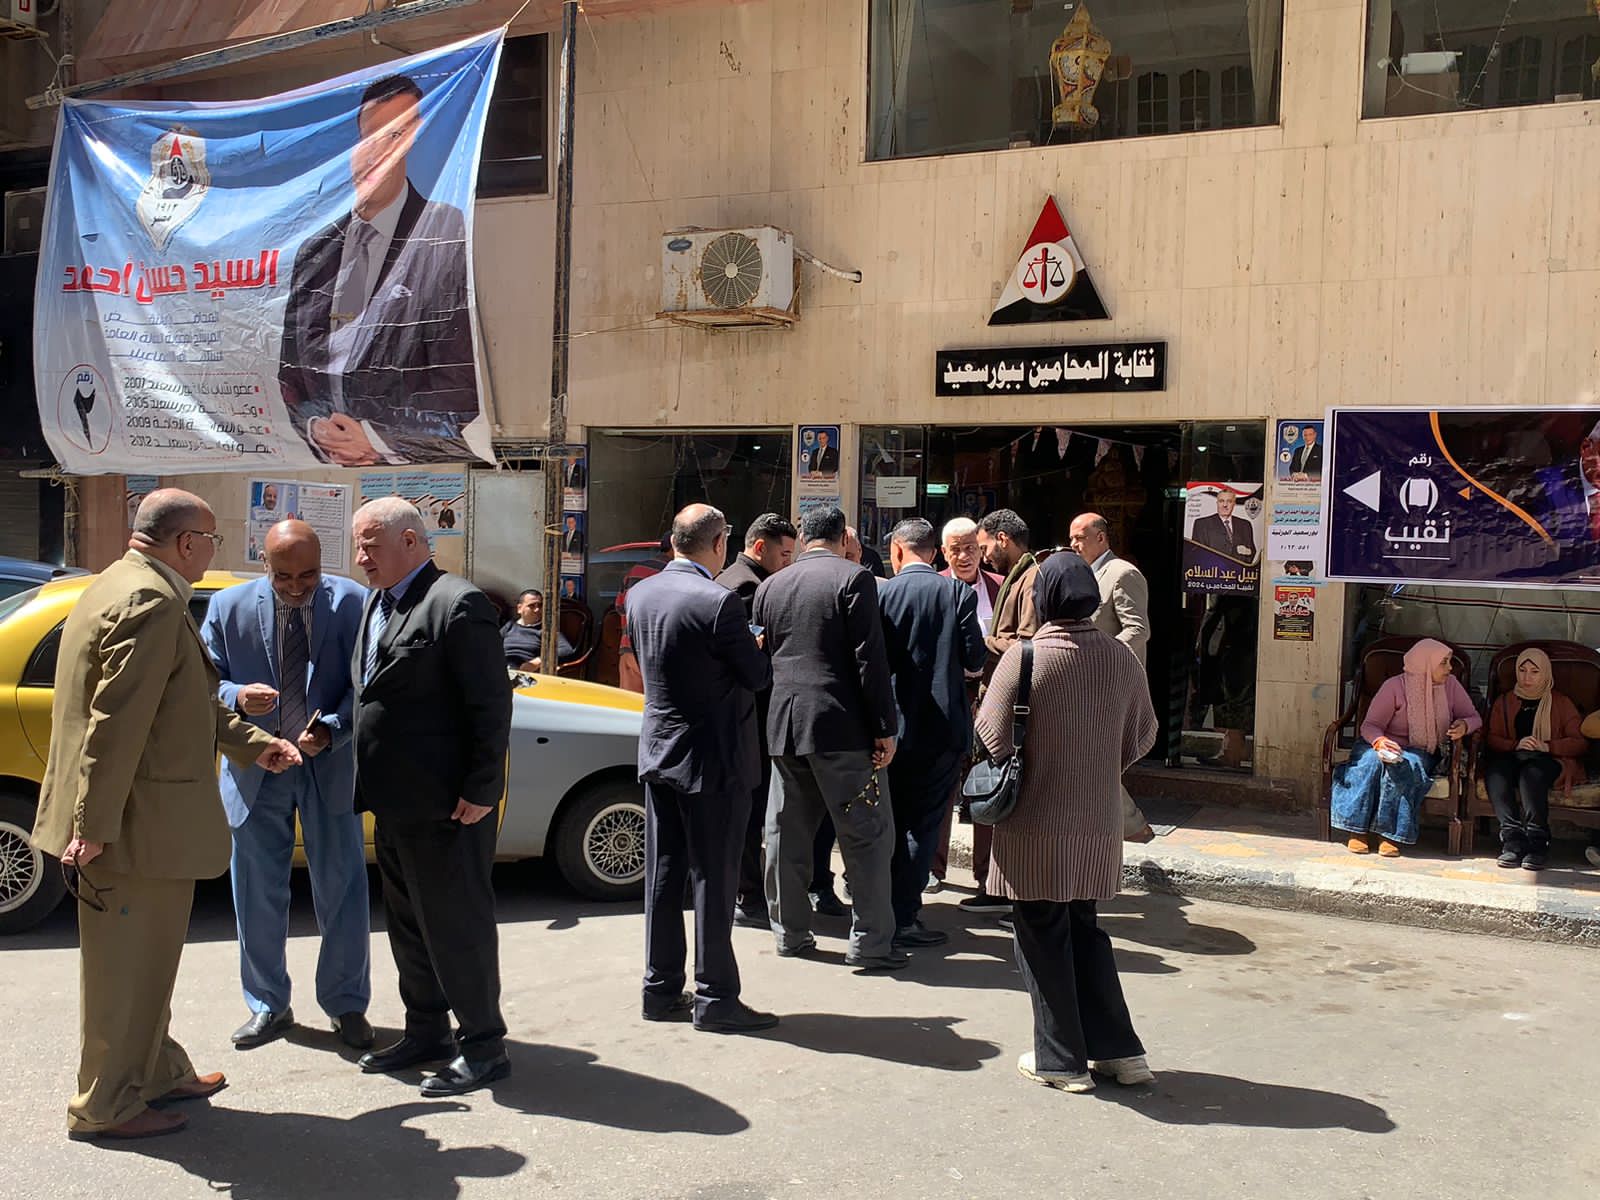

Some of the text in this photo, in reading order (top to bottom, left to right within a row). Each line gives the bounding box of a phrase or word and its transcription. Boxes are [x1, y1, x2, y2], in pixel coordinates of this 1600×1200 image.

[135, 261, 188, 304] حسن
[193, 249, 280, 300] السيد
[943, 347, 1155, 390] نقابة المحامين ببورسعيد
[76, 371, 94, 385] رقم
[233, 384, 254, 398] عضو
[126, 415, 151, 429] 2009
[1408, 453, 1433, 467] رقم
[1184, 565, 1259, 583] نبيل عبد السلام
